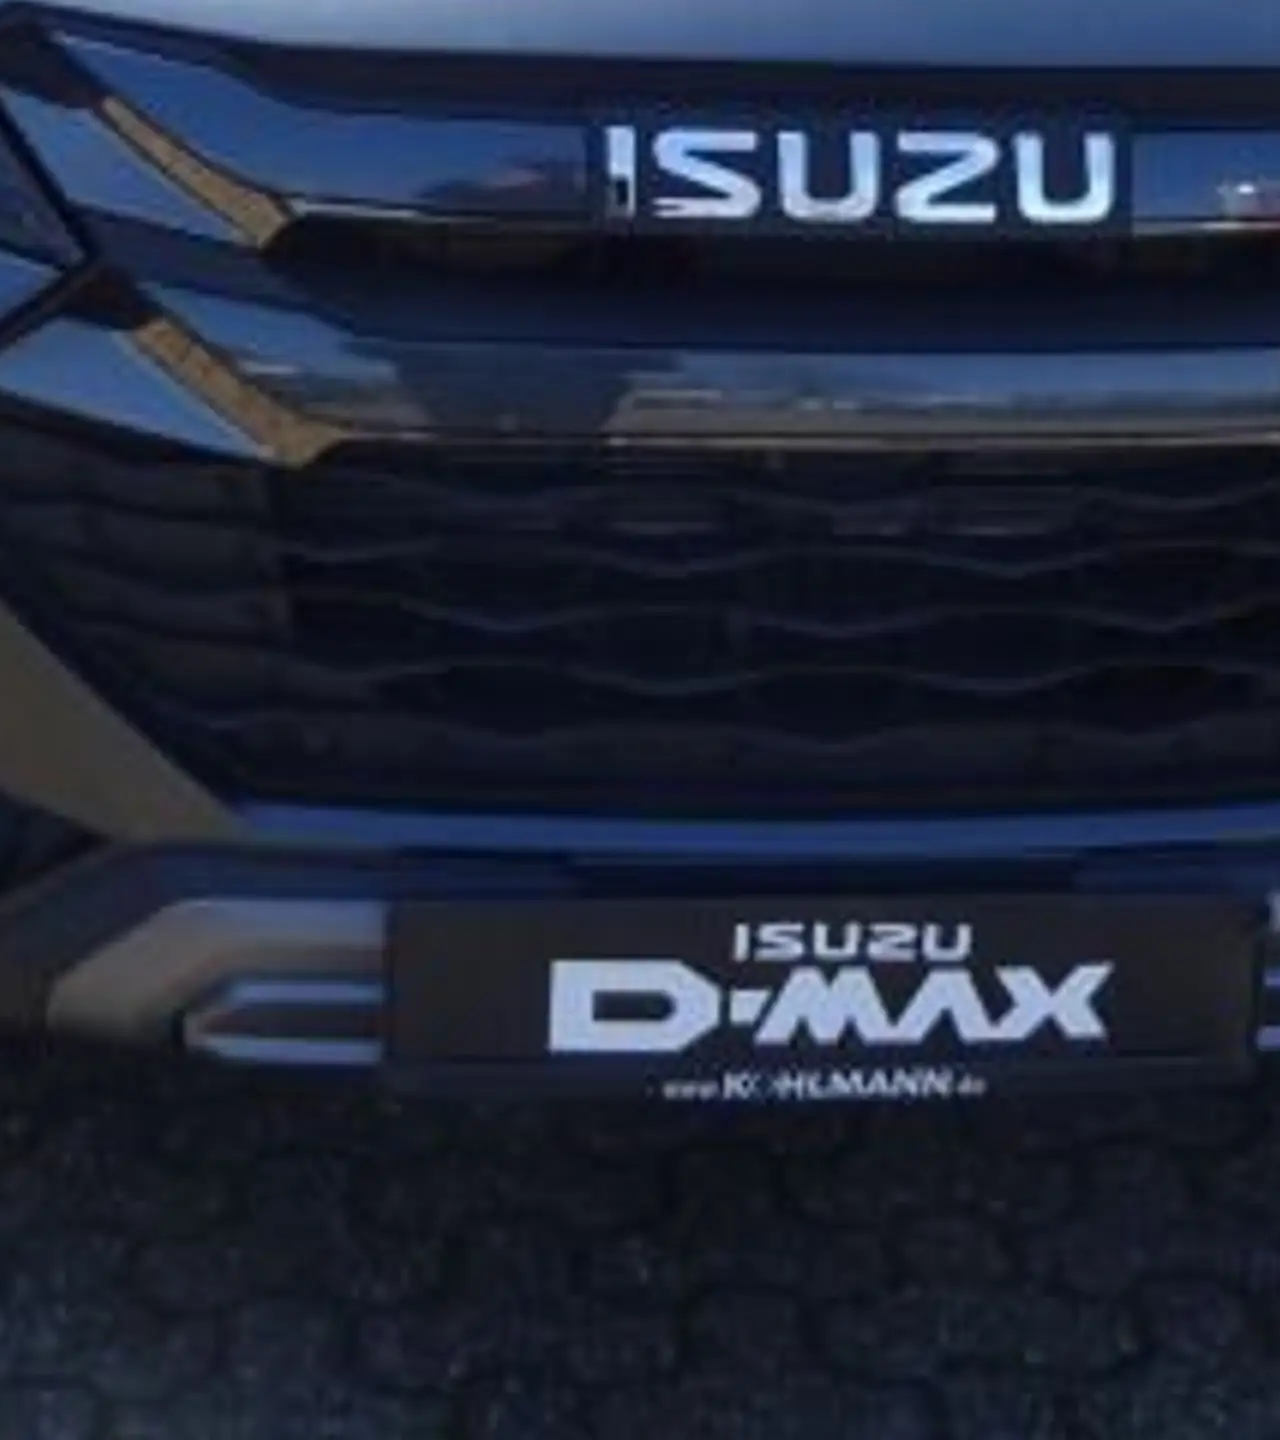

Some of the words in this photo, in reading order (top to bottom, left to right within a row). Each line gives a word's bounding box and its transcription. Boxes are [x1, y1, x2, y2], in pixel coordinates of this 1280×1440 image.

[605, 125, 1114, 223] ISUZU
[732, 921, 972, 962] ISUZU
[549, 960, 1114, 1052] D-MAX
